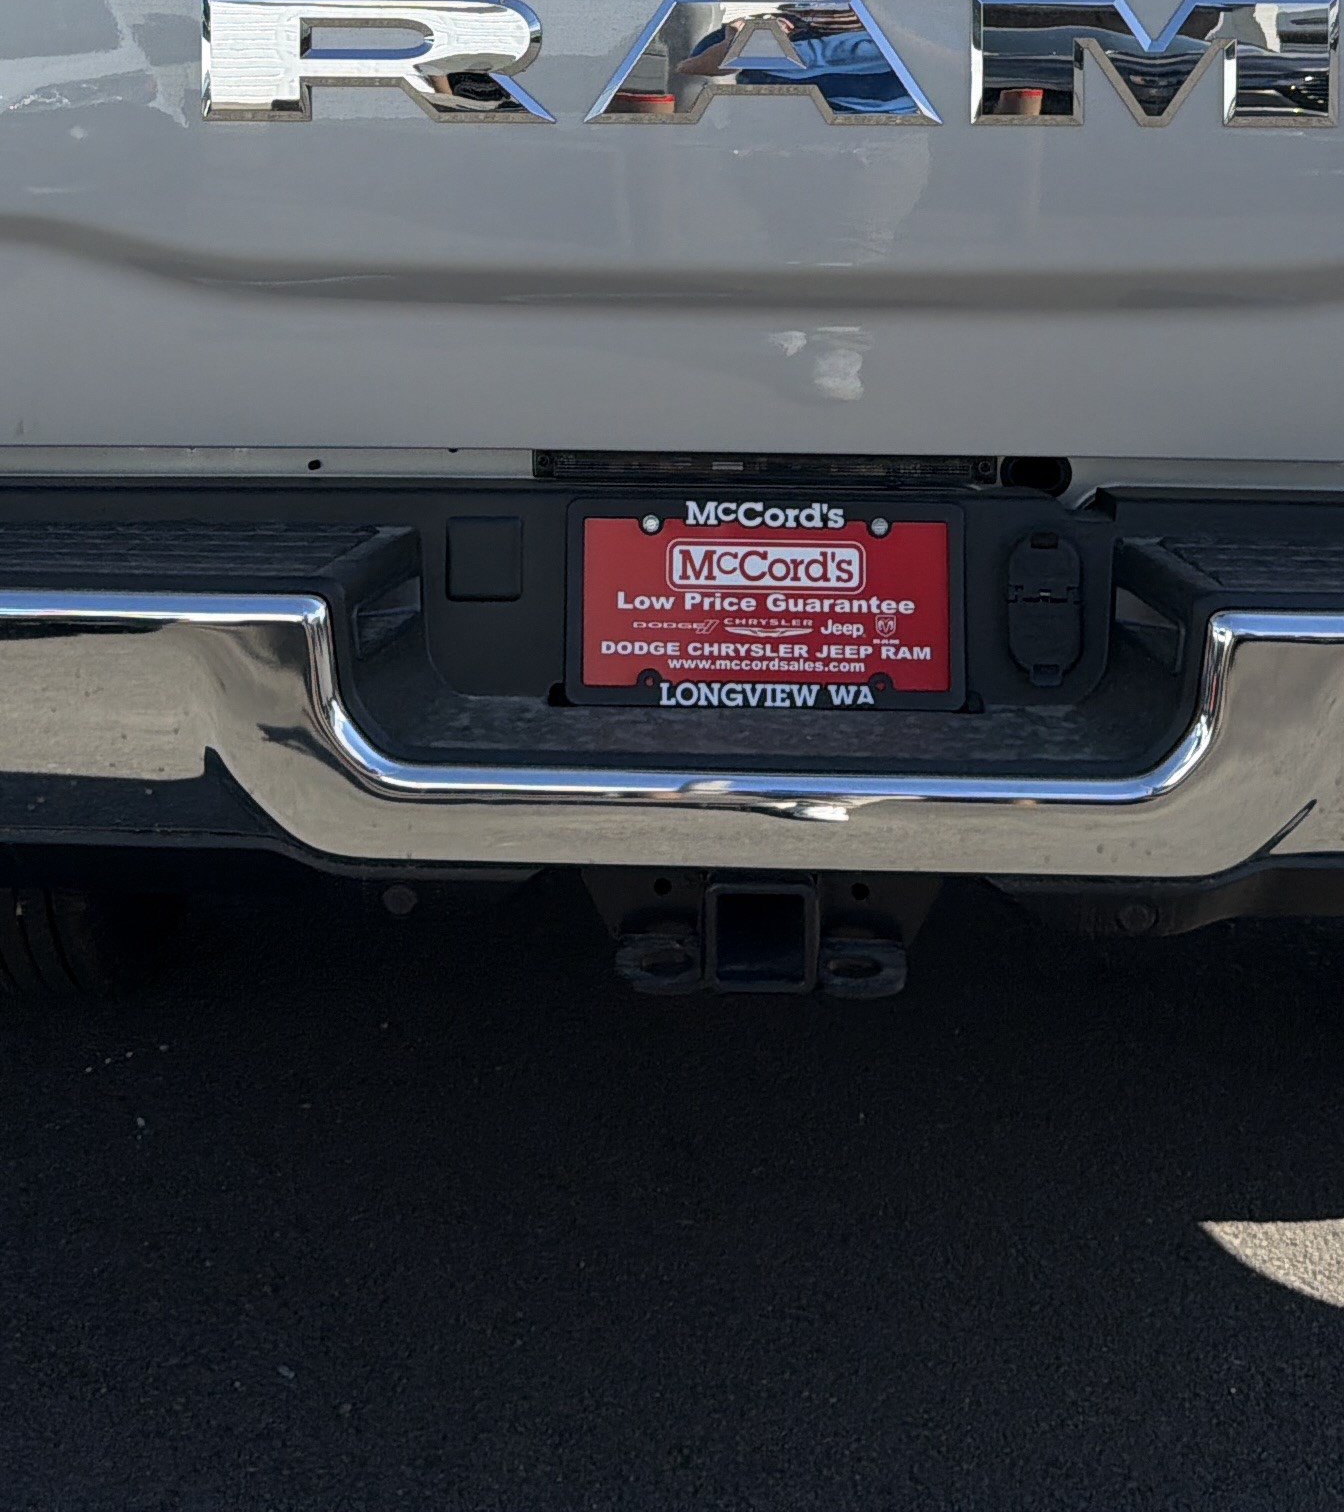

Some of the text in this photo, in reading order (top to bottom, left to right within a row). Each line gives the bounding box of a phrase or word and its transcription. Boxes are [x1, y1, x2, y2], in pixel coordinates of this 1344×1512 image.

[685, 500, 845, 529] McCord's
[679, 549, 854, 583] McCord's
[617, 591, 916, 614] Low Price Guarantee
[632, 621, 705, 629] DODGE
[723, 617, 813, 627] CHRYSLER
[820, 619, 864, 638] Jeep
[601, 641, 932, 661] DODGE CHRYSLER JEEP RAM
[667, 658, 866, 673] www.mccordsales.com
[659, 681, 875, 707] LONGVIEW WA
